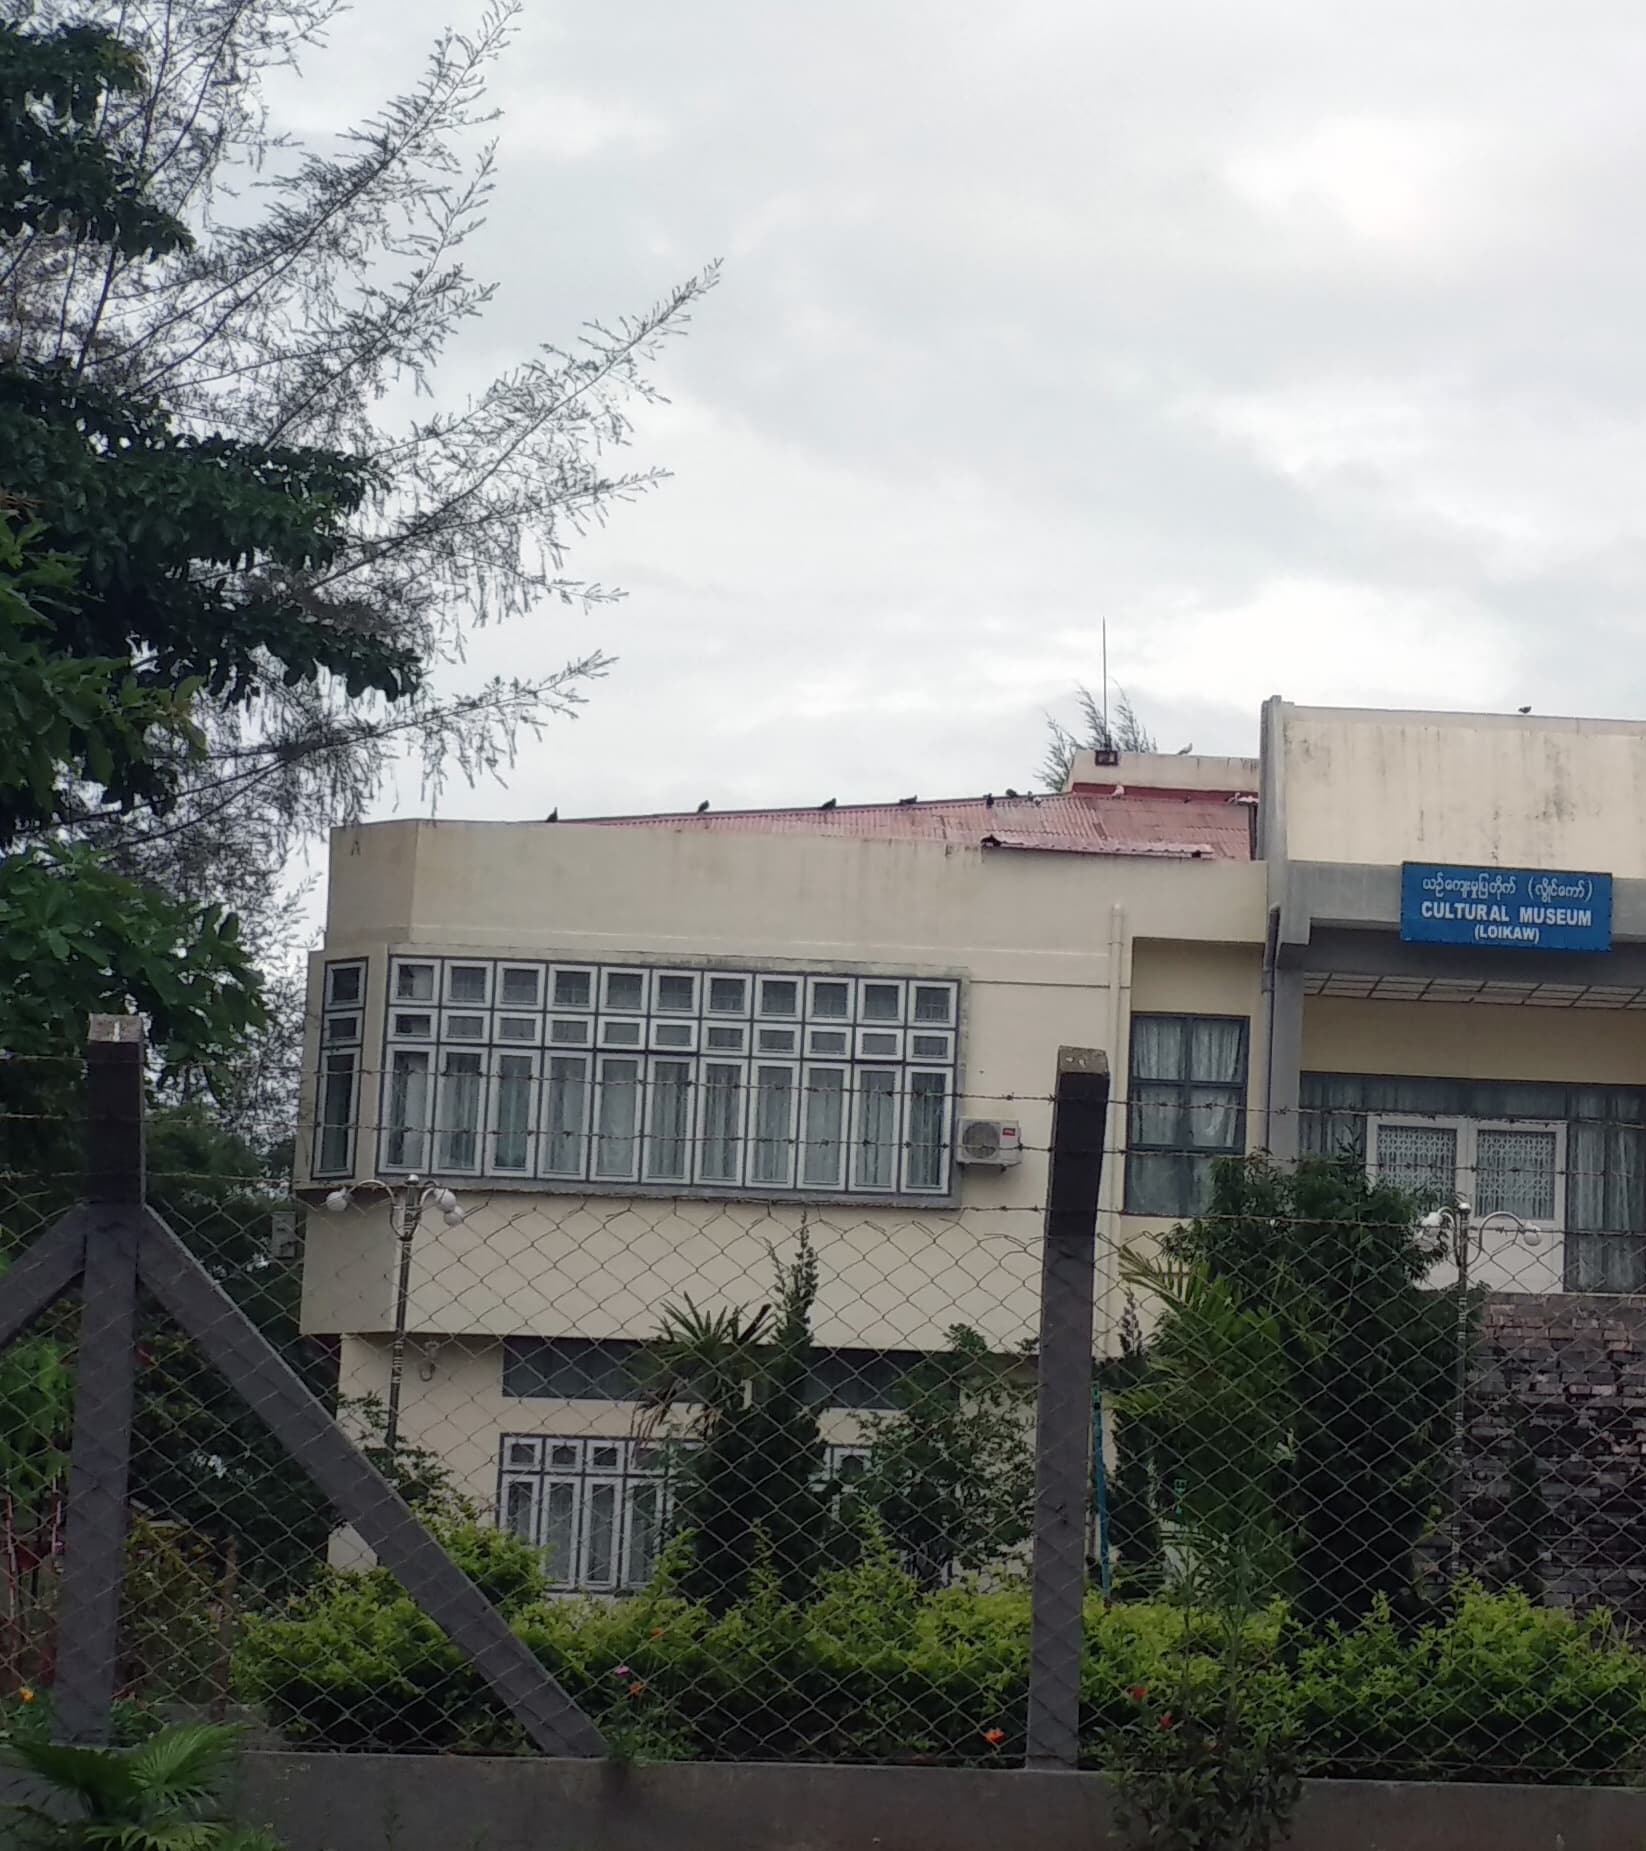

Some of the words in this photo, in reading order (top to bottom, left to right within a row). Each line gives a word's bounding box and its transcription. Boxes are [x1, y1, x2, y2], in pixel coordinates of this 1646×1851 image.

[1421, 901, 1510, 922] CULTURAL
[1519, 906, 1592, 927] MUSEUM
[1474, 924, 1540, 944] (LOIKAW)
